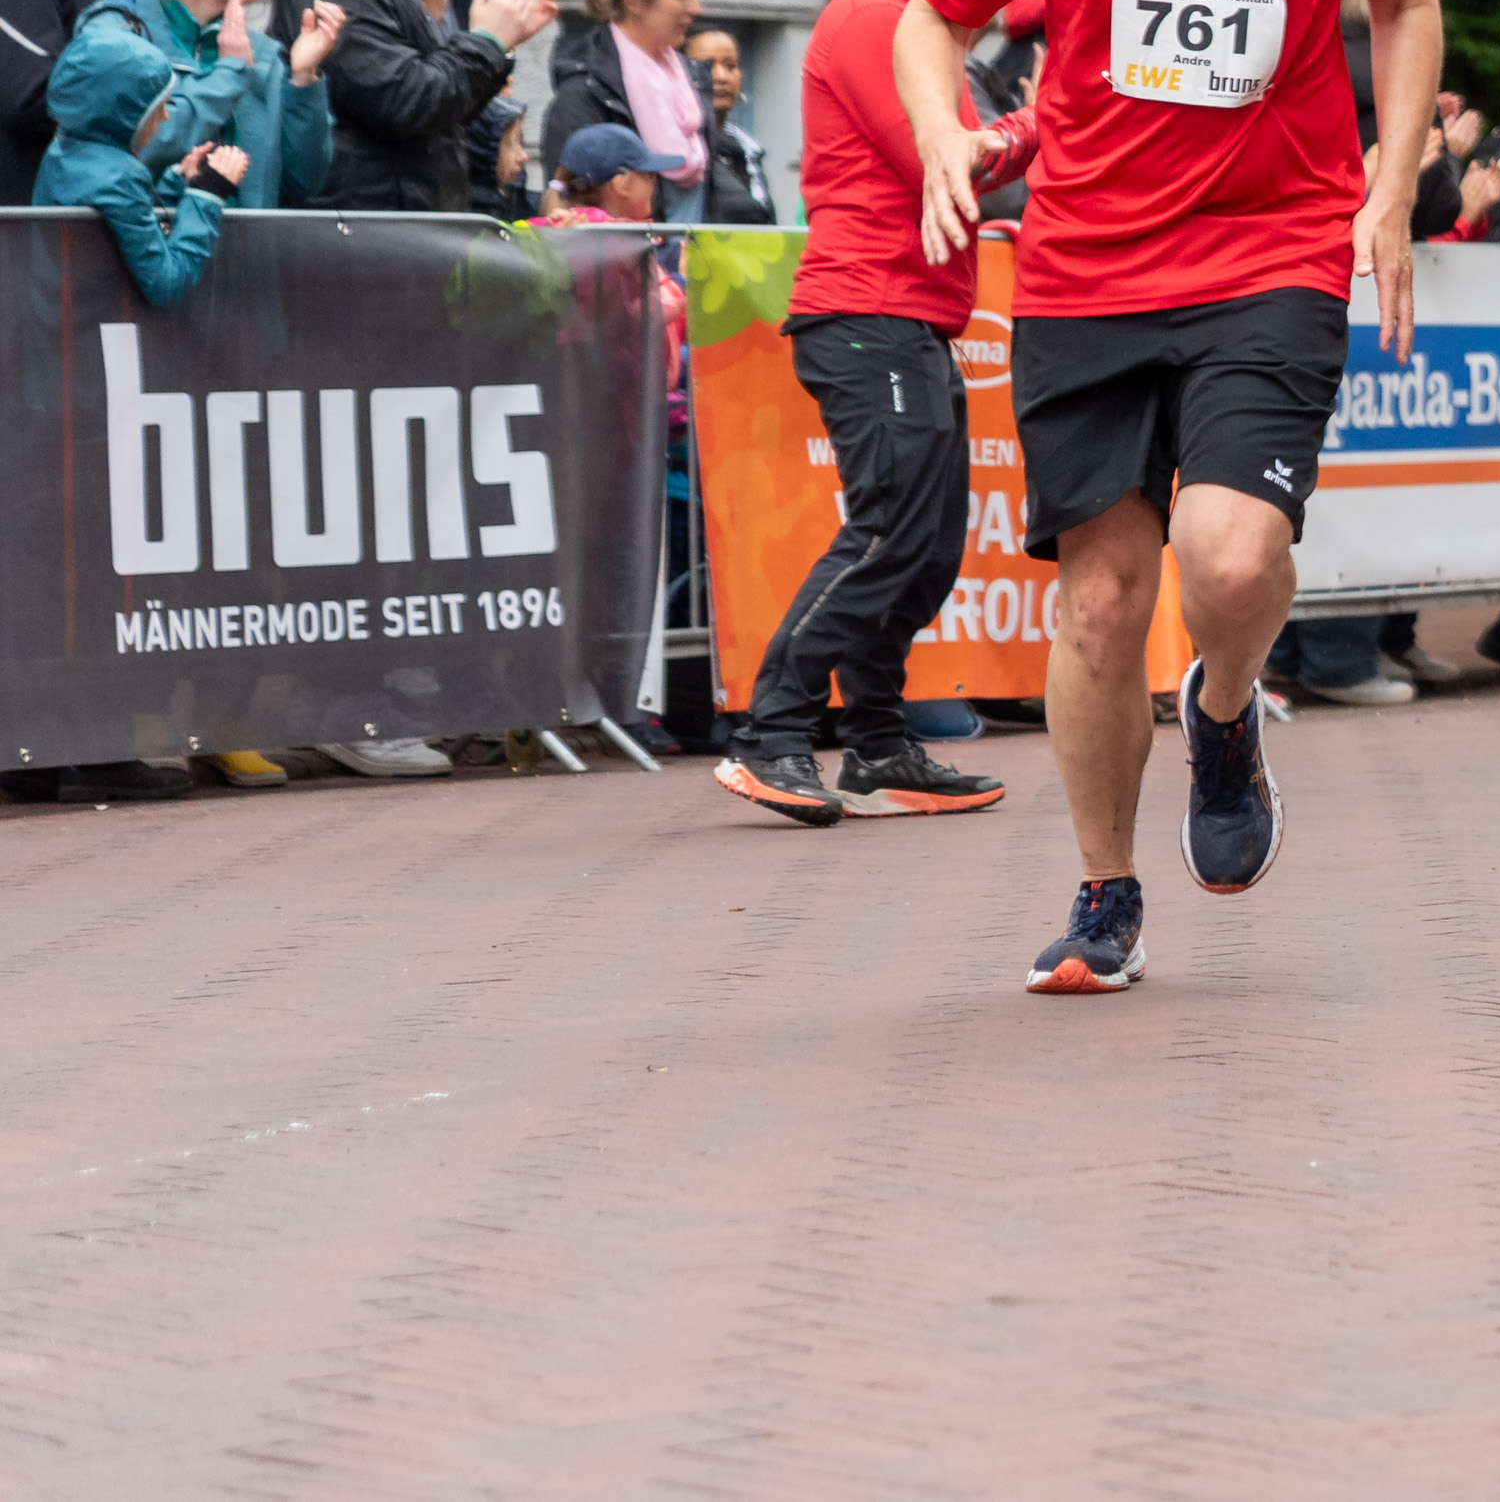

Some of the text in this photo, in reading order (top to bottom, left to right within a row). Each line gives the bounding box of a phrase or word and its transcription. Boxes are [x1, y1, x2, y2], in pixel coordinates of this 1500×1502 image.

[1135, 0, 1250, 56] 761
[1172, 54, 1212, 67] Andre
[1124, 63, 1184, 92] EWE
[1208, 70, 1261, 94] bruns
[100, 322, 559, 576] bruns
[1263, 468, 1294, 493] erima
[114, 587, 564, 654] MÄNNERMODE SEIT 1896
